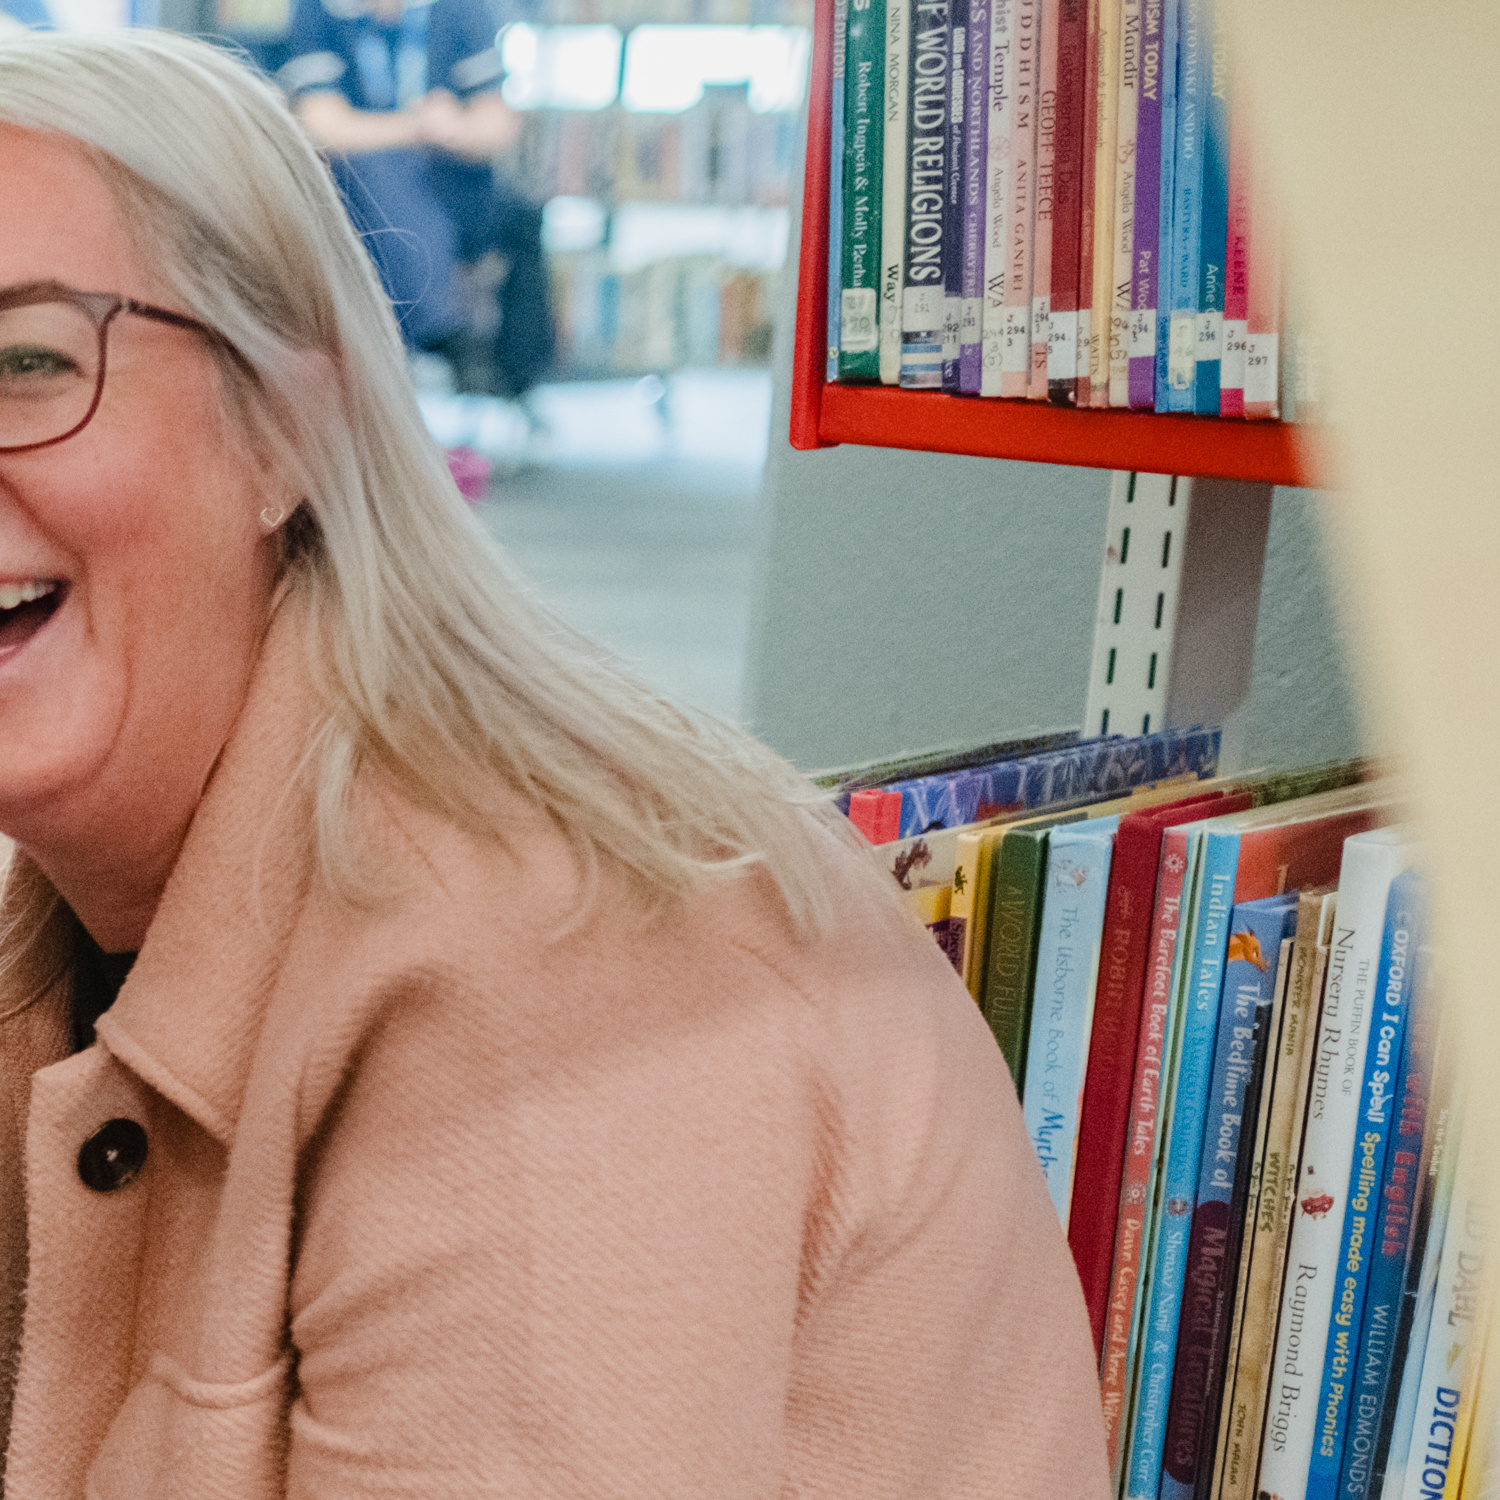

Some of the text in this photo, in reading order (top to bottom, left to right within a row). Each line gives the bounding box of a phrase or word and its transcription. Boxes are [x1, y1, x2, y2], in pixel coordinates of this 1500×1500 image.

[952, 27, 966, 53] GODS
[1122, 14, 1141, 90] Mandir
[1187, 28, 1197, 48] TO
[888, 6, 901, 122] NINA MORGAN
[1143, 40, 1159, 101] TODAY
[1186, 51, 1197, 96] MAKE
[855, 61, 872, 114] Robert
[950, 69, 965, 124] GODDESSES
[951, 124, 960, 135] of
[1183, 96, 1197, 133] AND
[853, 118, 871, 173] Ingpen
[908, 23, 948, 281] WORLD RELIGIONS
[965, 29, 984, 298] AND NORTHLANDS CHERRYTRE
[988, 39, 1010, 248] Temple Angela Wood
[1037, 90, 1056, 221] GEOFF TEECE
[1182, 136, 1194, 159] DO
[855, 176, 868, 191] &
[1015, 159, 1027, 214] ANITA
[1120, 170, 1134, 213] Angela
[850, 195, 869, 240] Molly
[1120, 218, 1132, 254] Wood
[852, 244, 868, 288] Perha
[1013, 223, 1025, 292] GANERI
[1137, 250, 1152, 312] Pat Woo
[1205, 263, 1219, 303] Anne
[1006, 314, 1014, 323] J
[1006, 325, 1026, 335] 294
[1199, 330, 1216, 342] 296
[1006, 338, 1013, 347] 3
[1089, 333, 1101, 376] WATTS
[1226, 341, 1247, 351] 296
[1248, 355, 1268, 366] 297
[1061, 905, 1081, 939] The
[1161, 895, 1181, 923] The
[1049, 946, 1074, 1023] Usborne
[1152, 928, 1177, 997] Barefoot
[1322, 926, 1357, 1019] Nursery
[1148, 1003, 1168, 1040] Book
[1285, 1013, 1300, 1057] MANIA
[1341, 958, 1371, 1097] THE PUFFIN BOOK OF
[1042, 1029, 1065, 1073] Book
[1144, 1045, 1163, 1063] of
[1312, 1025, 1342, 1121] Rhymes
[1042, 1080, 1060, 1101] of
[1139, 1067, 1162, 1113] Earth
[1209, 981, 1261, 1189] The Bedtime Book of
[1134, 1119, 1154, 1156] Tales
[1137, 873, 1231, 1481] Indian Tales Shenaaz Nanji & Christopher Corr
[1258, 1151, 1281, 1234] WITCHES
[1320, 929, 1410, 1458] OXFORD I Can Spell Spelling made easy with Phonics
[1380, 1150, 1417, 1257] English
[1123, 1218, 1141, 1264] Dawn
[1111, 1266, 1137, 1311] Casey
[1188, 1226, 1228, 1333] Magical
[1112, 1314, 1128, 1344] and
[1281, 1263, 1319, 1377] Raymond
[1106, 1346, 1125, 1388] Anne
[1361, 1304, 1391, 1386] WILLIAM
[1234, 1402, 1248, 1438] JOHN
[1270, 1383, 1302, 1454] Briggs
[1228, 1442, 1243, 1486] MALAM
[1346, 1394, 1377, 1494] EDMONDS
